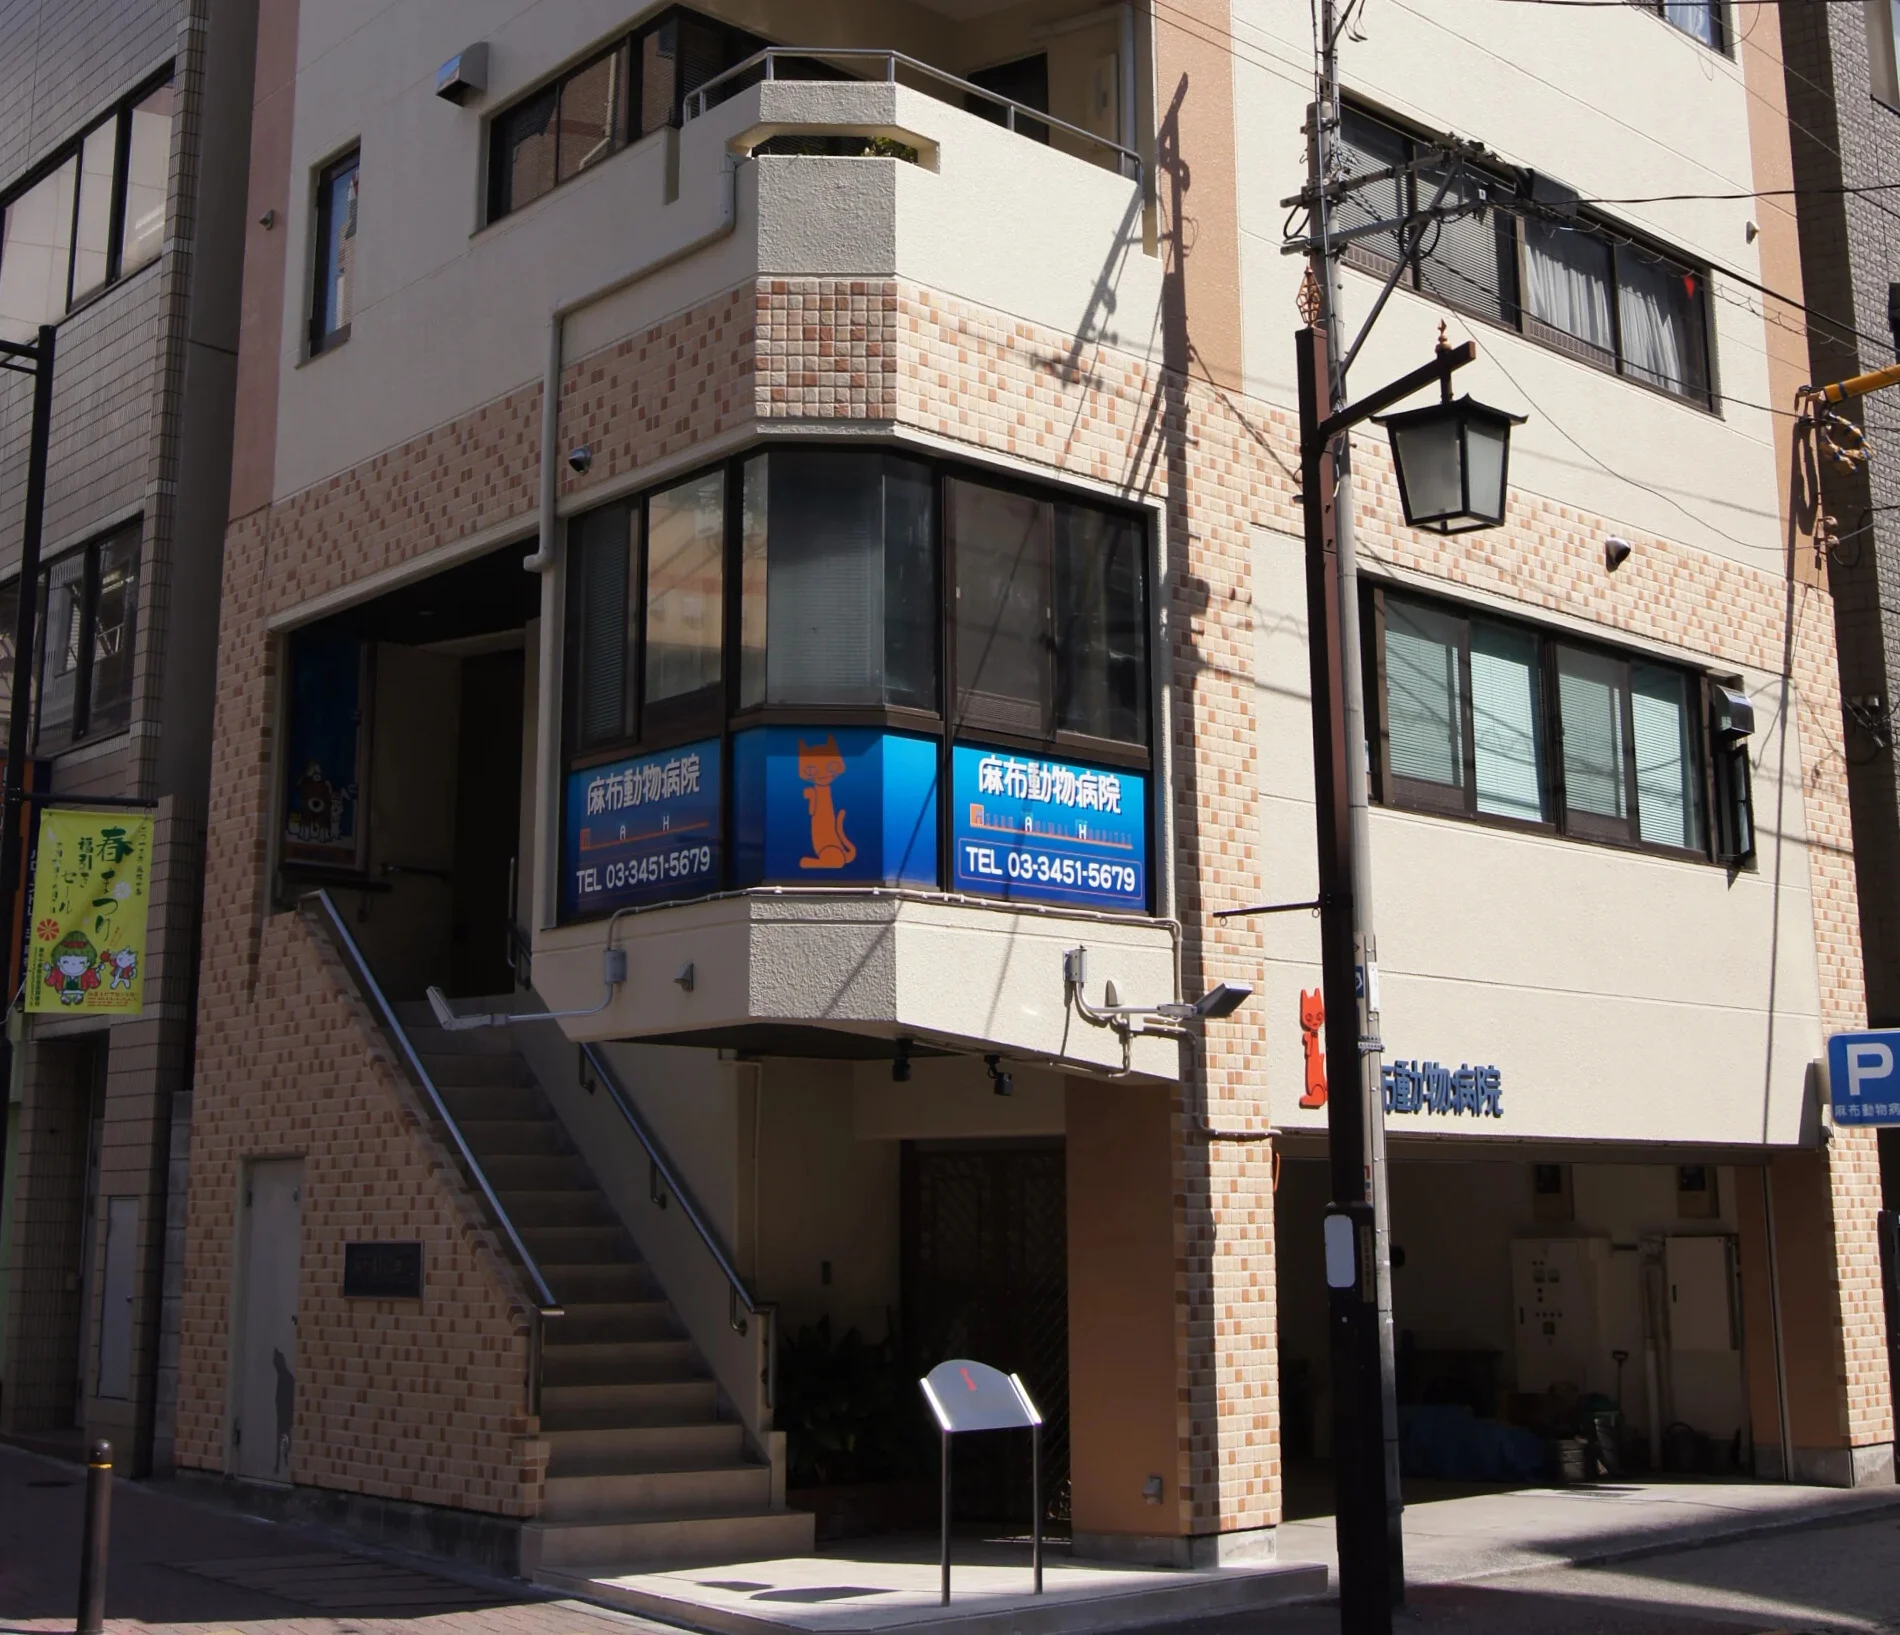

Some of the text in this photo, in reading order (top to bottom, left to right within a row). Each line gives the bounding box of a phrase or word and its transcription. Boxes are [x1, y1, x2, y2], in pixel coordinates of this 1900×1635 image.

[587, 753, 700, 816] 麻布動物病院
[978, 754, 1121, 813] 麻布動物病院
[91, 825, 133, 941] 春まつり
[576, 846, 711, 894] TEL 03-3451-5679
[965, 846, 1136, 892] TEL 03-3451-5679
[1846, 1043, 1894, 1096] P
